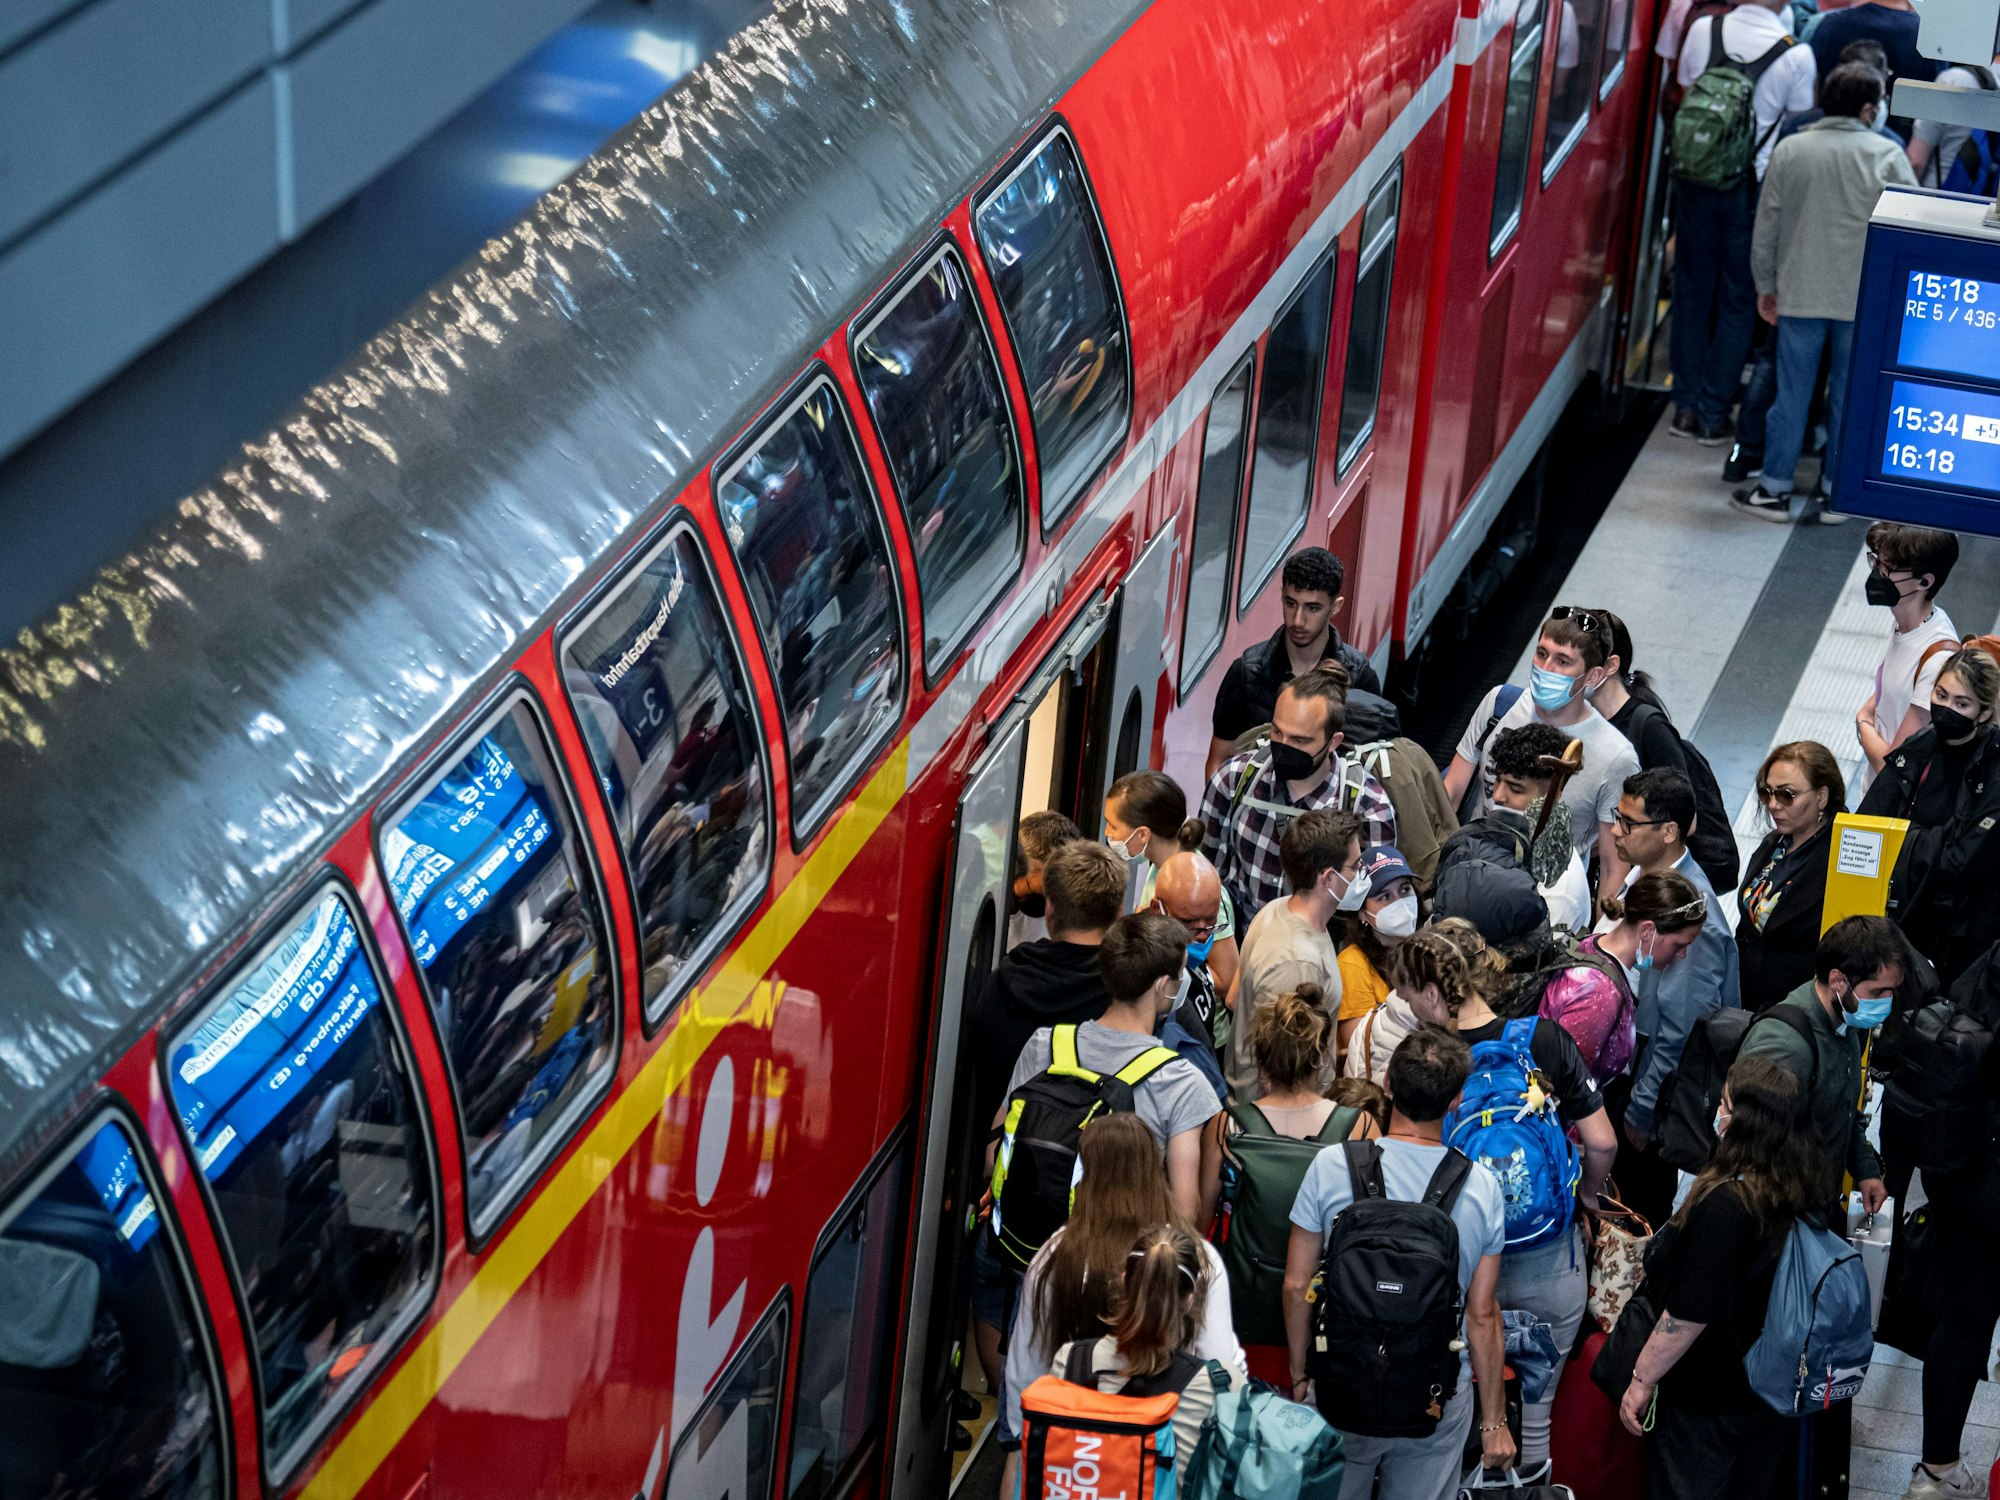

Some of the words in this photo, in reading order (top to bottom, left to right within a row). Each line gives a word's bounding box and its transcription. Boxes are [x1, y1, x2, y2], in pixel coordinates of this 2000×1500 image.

[1912, 273, 1980, 304] 15:18
[1906, 299, 1928, 319] RE
[1933, 303, 1943, 321] 5
[1964, 308, 2000, 329] 436
[1892, 405, 1959, 437] 15:34
[1975, 423, 1999, 439] +5
[1887, 442, 1955, 474] 16:18
[1843, 841, 1873, 850] Bandansage
[1851, 849, 1871, 857] Anzeige
